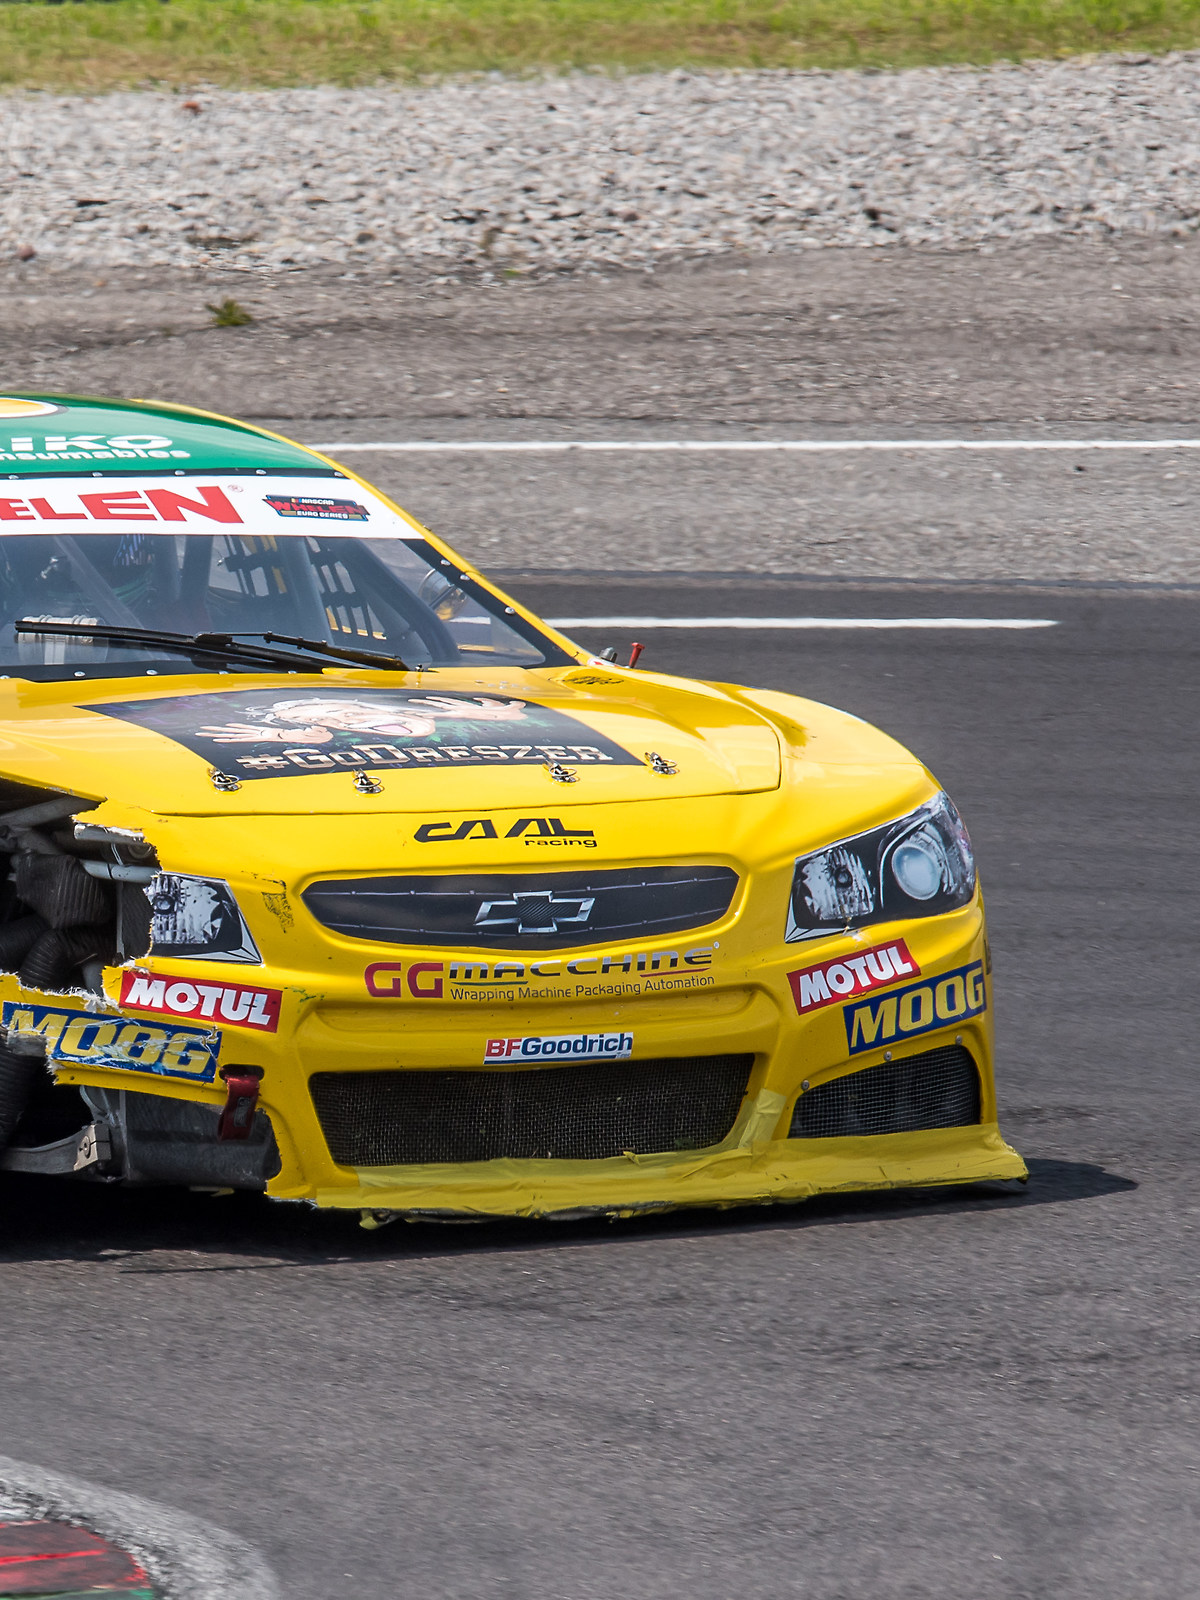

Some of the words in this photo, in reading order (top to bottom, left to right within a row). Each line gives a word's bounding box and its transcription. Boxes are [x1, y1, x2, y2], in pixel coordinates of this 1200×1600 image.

[265, 500, 370, 516] WHELEN
[296, 510, 319, 518] EURO
[319, 511, 349, 519] SERIES
[414, 818, 595, 842] CAAL
[525, 837, 598, 848] racing
[364, 961, 444, 998] GG
[451, 987, 515, 1002] Wrapping
[519, 986, 572, 999] Machine
[576, 981, 641, 997] Packaging
[644, 975, 715, 992] Automation
[800, 946, 913, 1008] MOTUL
[125, 977, 272, 1026] MOTUL
[851, 967, 984, 1048] MOOG
[7, 1009, 218, 1074] MOOG
[485, 1032, 633, 1057] BFGoodrich
